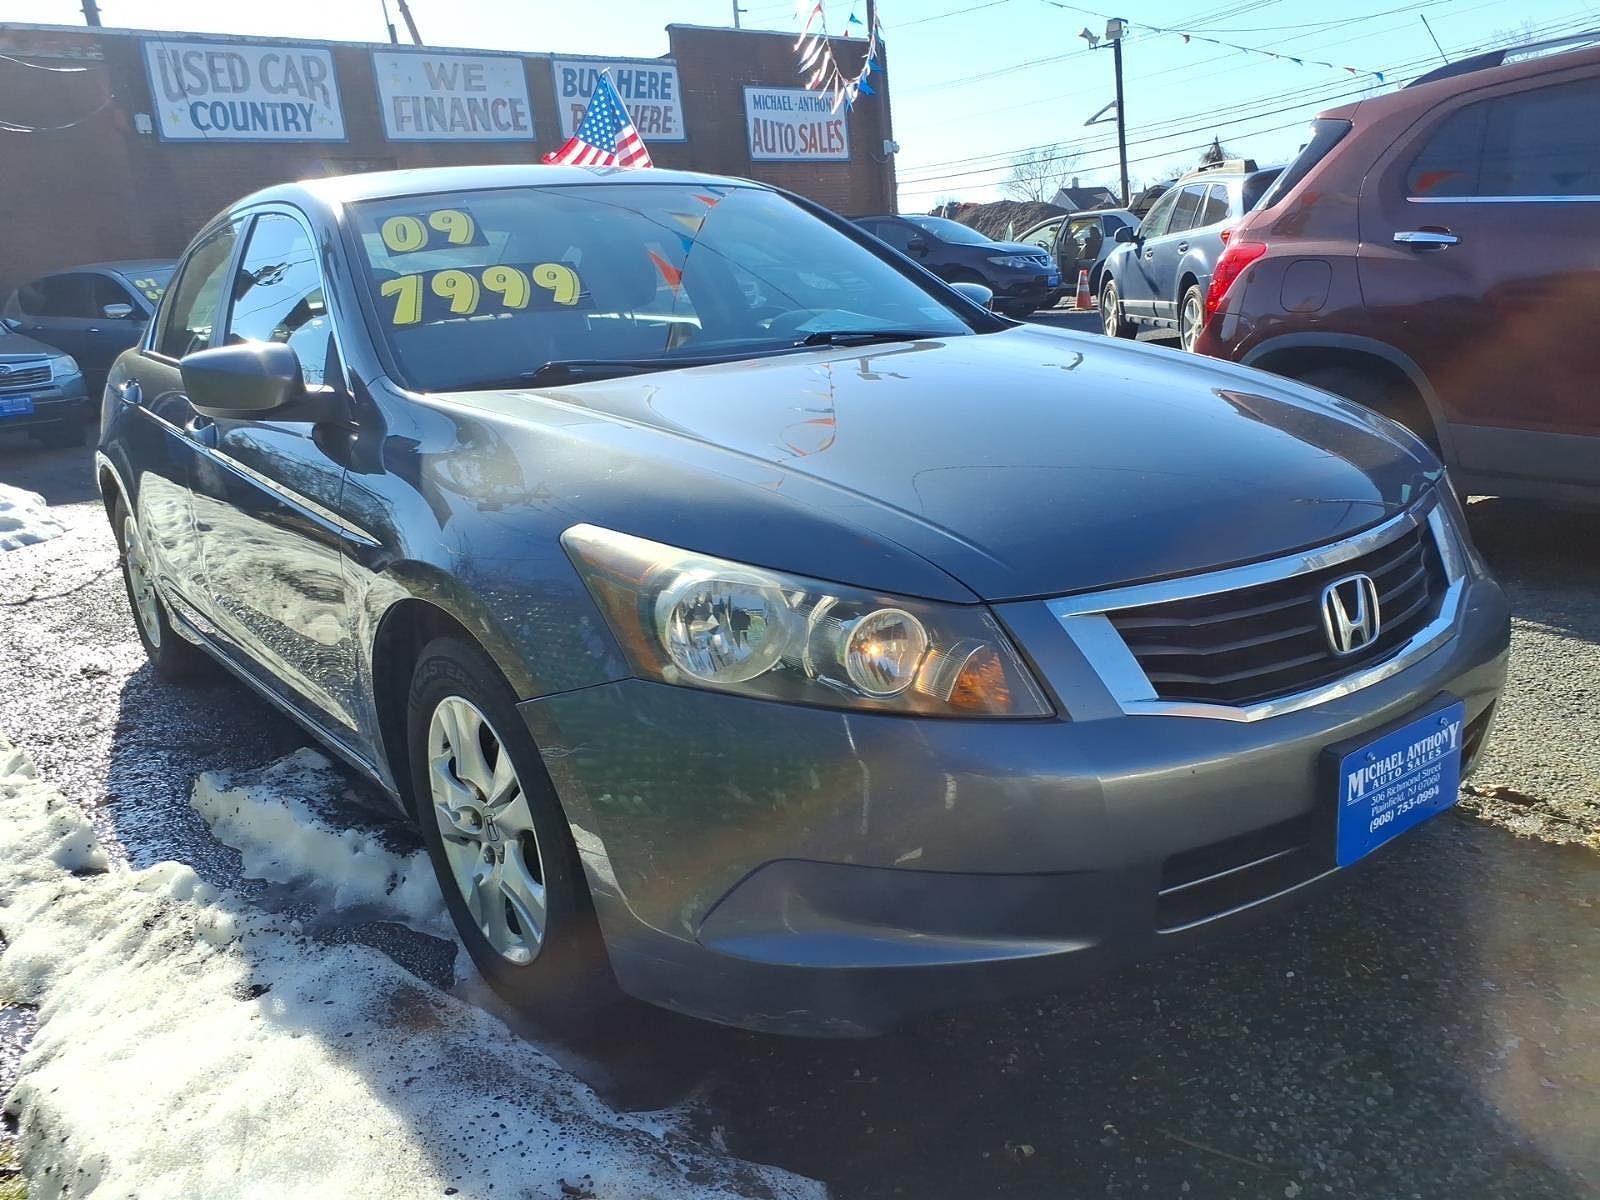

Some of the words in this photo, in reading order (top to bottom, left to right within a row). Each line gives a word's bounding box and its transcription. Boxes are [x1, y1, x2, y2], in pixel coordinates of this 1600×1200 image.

[156, 49, 251, 103] USED
[258, 53, 331, 110] CAR
[423, 61, 487, 92] WE
[616, 69, 673, 100] HERE
[189, 101, 314, 132] COUNTRY
[392, 96, 528, 132] FINANCE
[752, 94, 794, 112] MICHAEL
[798, 96, 834, 112] ANTHON
[752, 117, 796, 153] AUTO
[798, 119, 845, 153] SALES
[381, 209, 475, 252] 09
[381, 262, 581, 325] 7999
[1347, 751, 1405, 802] MICHAEL
[1406, 720, 1461, 762] ANTHONY
[1372, 767, 1402, 790] AUTO
[1407, 747, 1442, 771] SALES
[1386, 772, 1421, 798] Richmond
[1421, 762, 1442, 779] Street
[1369, 809, 1395, 833] (908)
